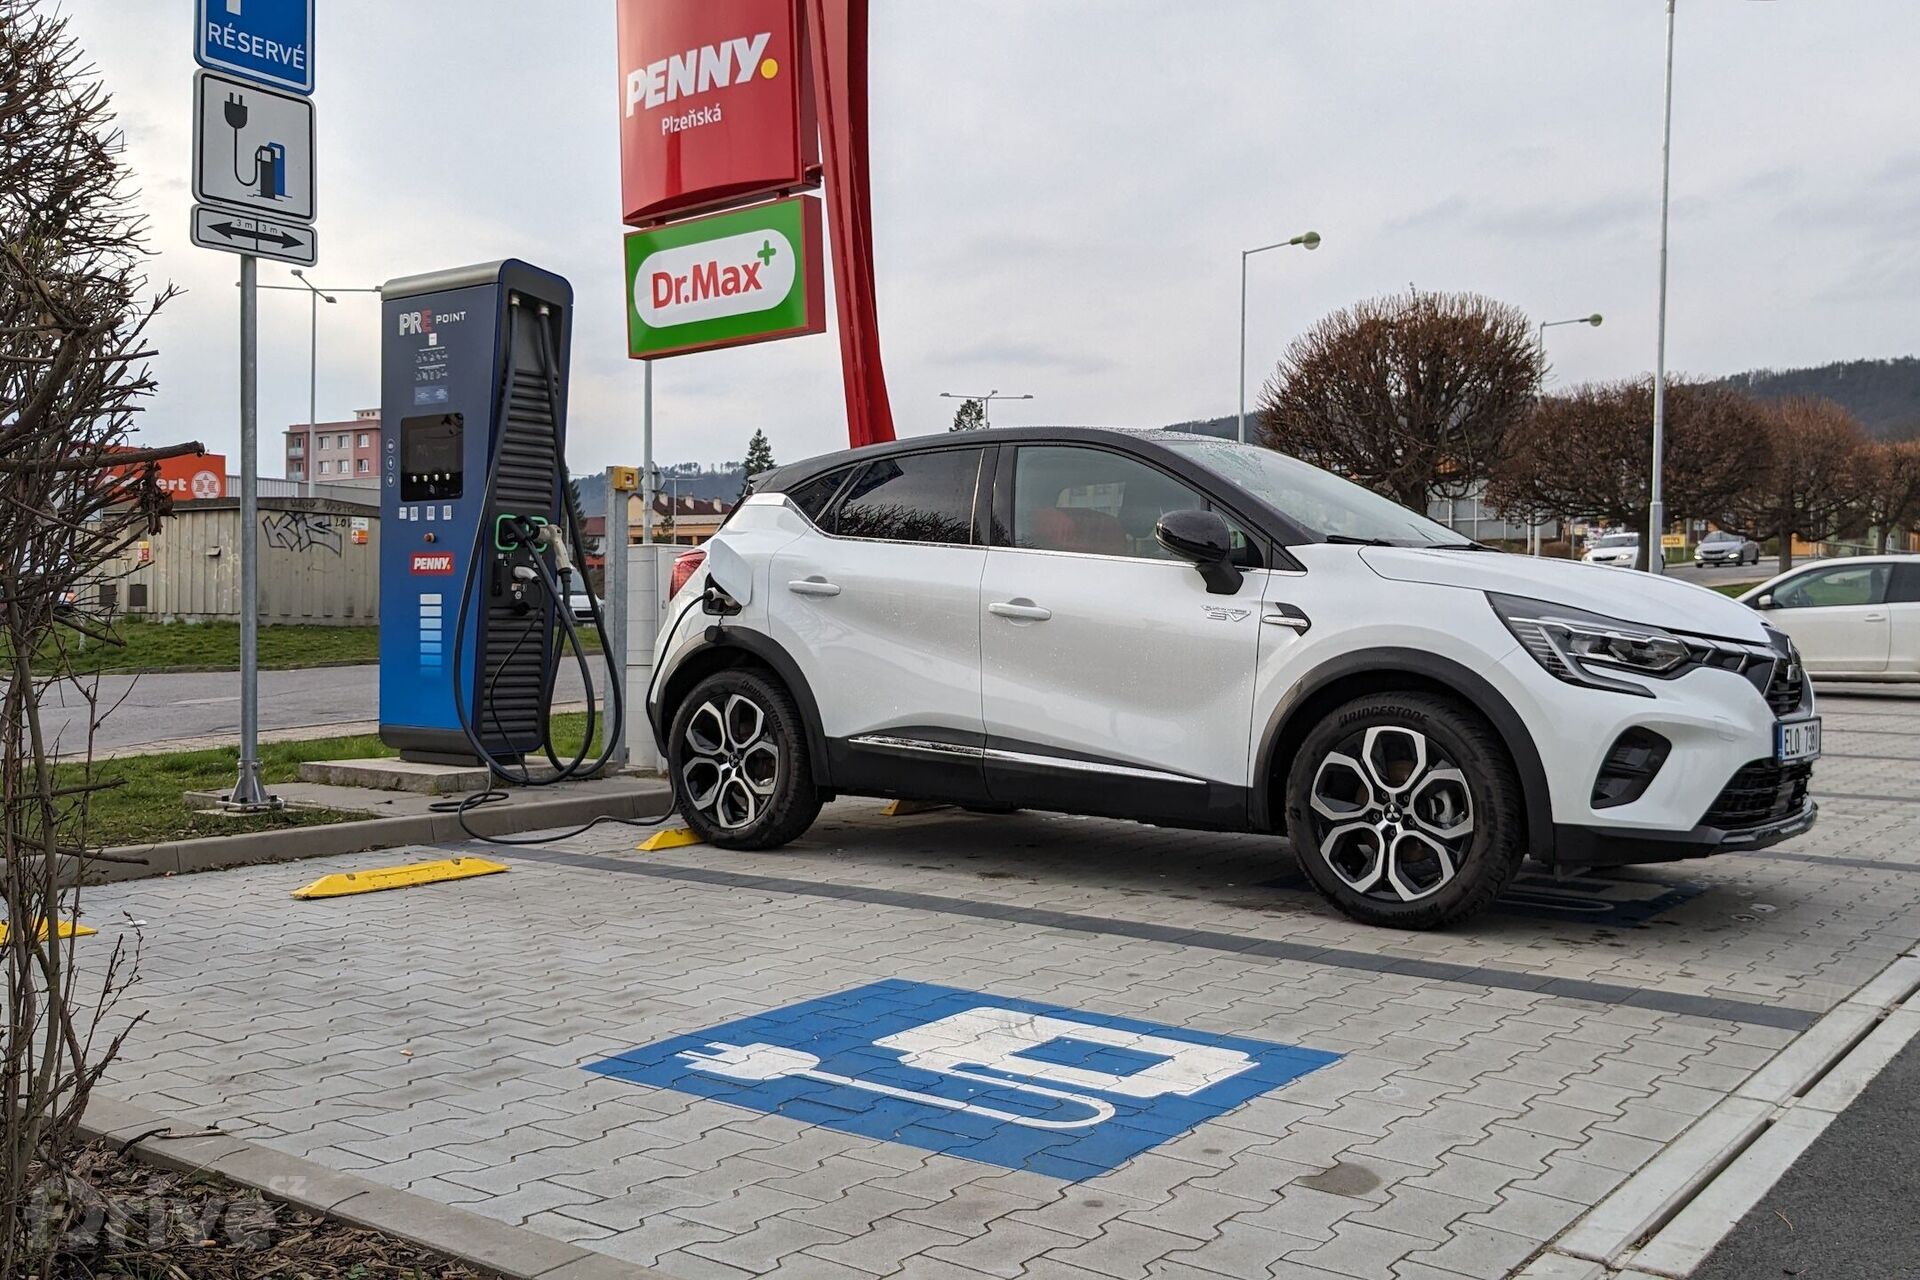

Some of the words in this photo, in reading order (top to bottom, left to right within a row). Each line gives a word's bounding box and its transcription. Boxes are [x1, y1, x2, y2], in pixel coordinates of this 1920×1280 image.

[208, 21, 305, 70] RÉSERVÉ
[661, 103, 722, 136] Plzeňská
[399, 308, 433, 336] PRE
[435, 311, 467, 325] POINT
